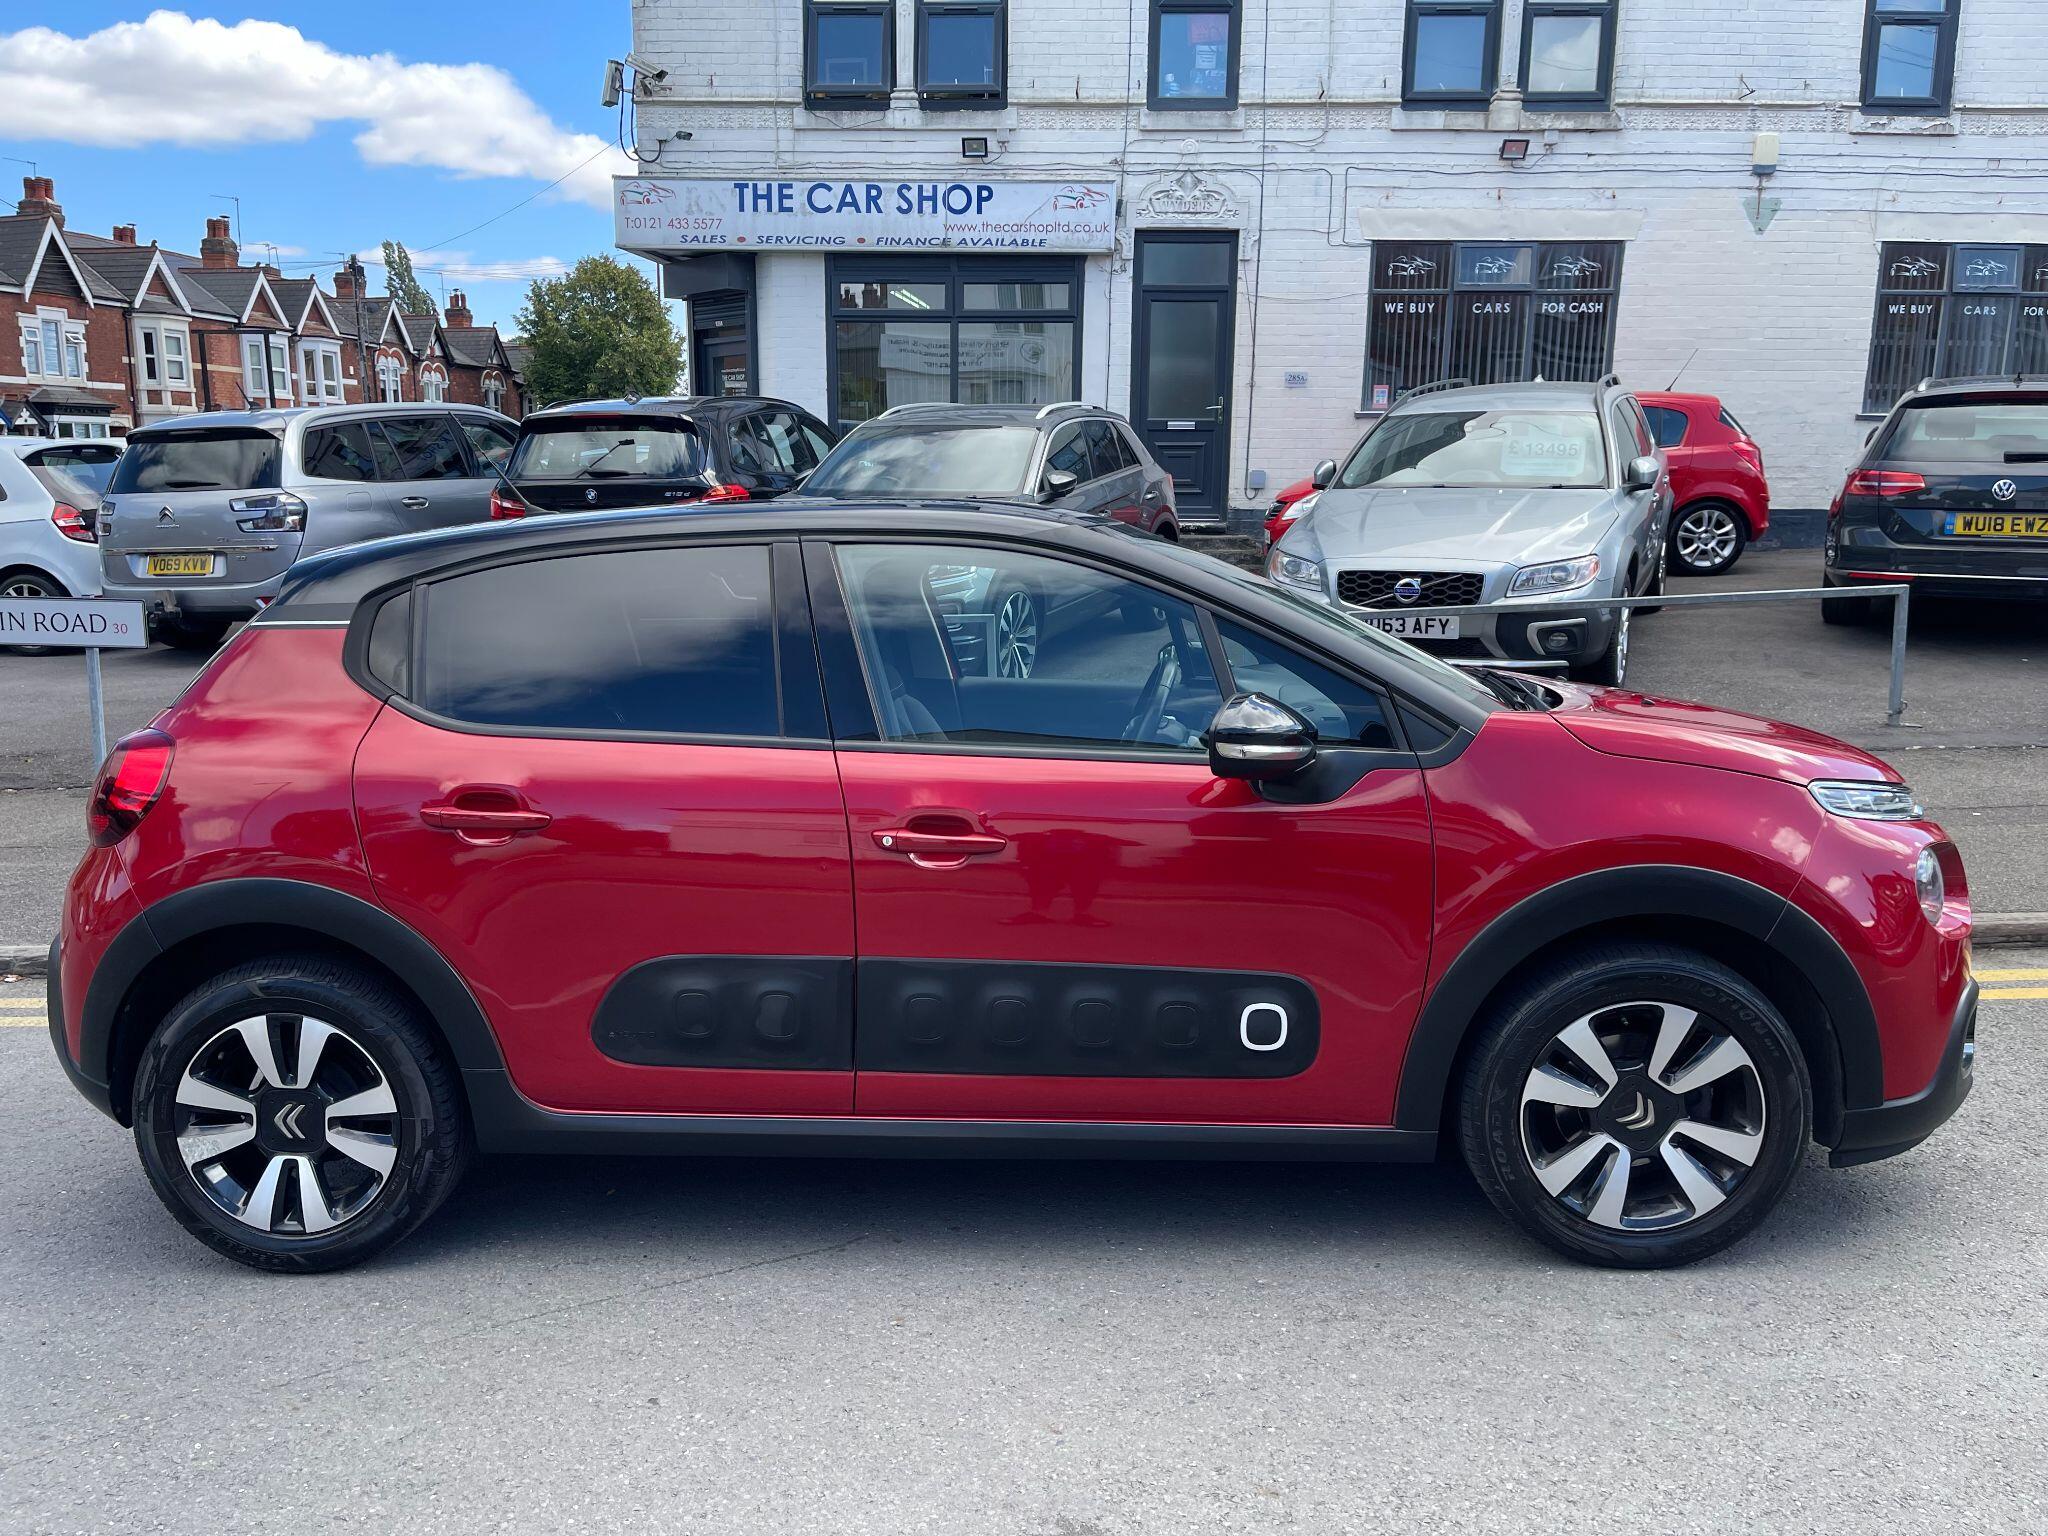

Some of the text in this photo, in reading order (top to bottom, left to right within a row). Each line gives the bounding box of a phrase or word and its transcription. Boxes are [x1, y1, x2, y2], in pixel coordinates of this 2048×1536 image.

[733, 182, 794, 213] THE
[806, 182, 883, 214] CAR
[895, 183, 994, 215] SHOP
[624, 217, 723, 230] T:0121 433 5577
[943, 220, 1110, 235] www.thecarshopltd.co.uk
[680, 234, 1048, 248] SALES SERVICING FINANCE AVAILABLE
[1384, 302, 1604, 314] WE BUY CARS FOR CASH
[1888, 304, 1906, 314] WE
[1910, 304, 1934, 314] BUY
[1963, 306, 1997, 316] CARS
[2023, 306, 2044, 316] FOR
[1525, 442, 1579, 457] 13495
[1962, 516, 2005, 532] WU18
[33, 612, 107, 634] ROAD
[112, 623, 128, 634] 30
[1412, 617, 1450, 635] AFY
